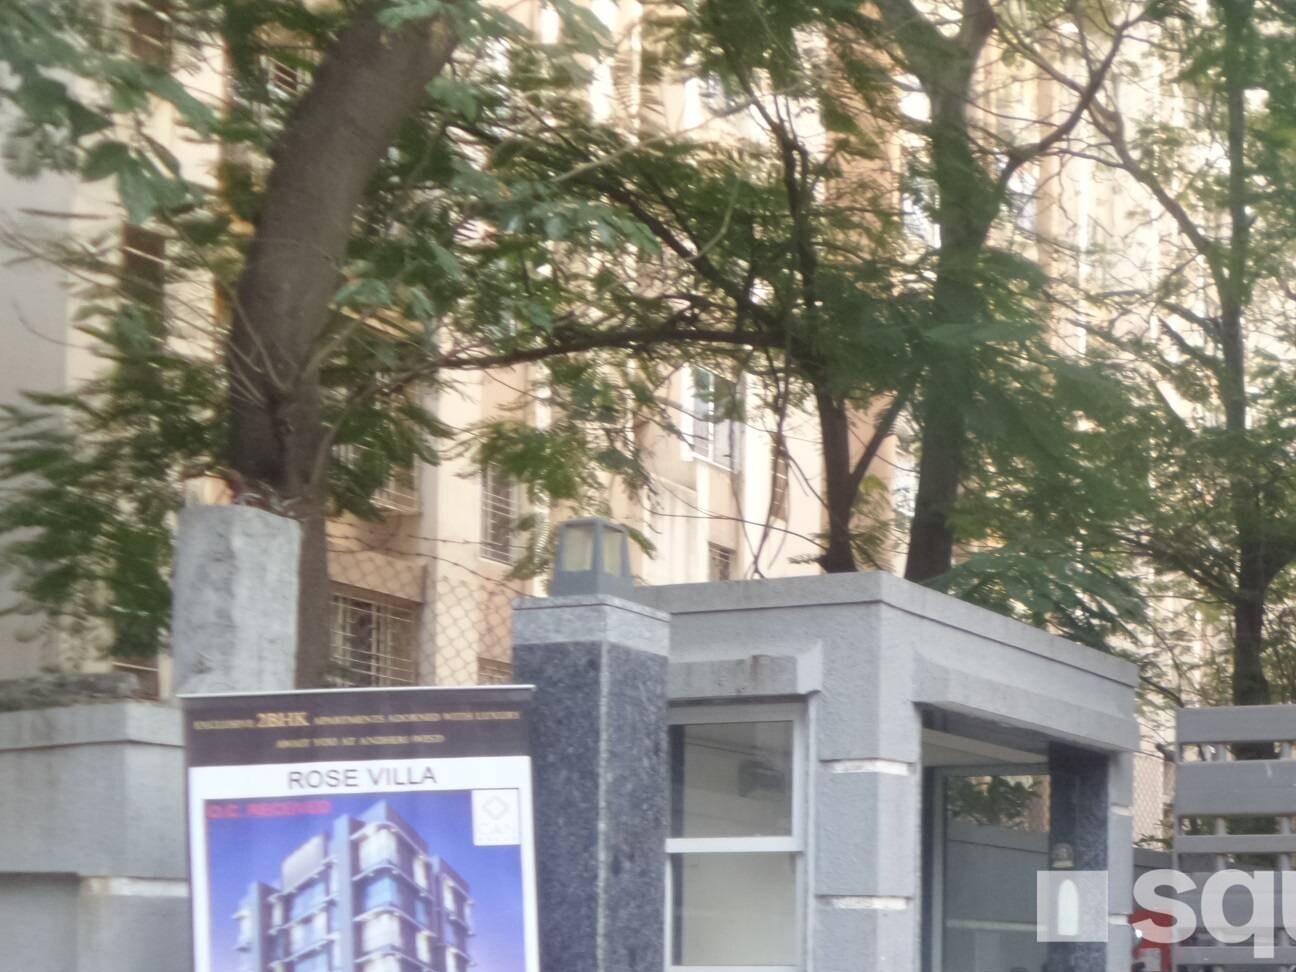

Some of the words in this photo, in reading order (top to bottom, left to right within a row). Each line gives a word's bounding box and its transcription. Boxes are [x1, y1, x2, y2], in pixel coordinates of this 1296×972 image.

[256, 711, 310, 728] 2BHK
[288, 768, 360, 791] ROSE
[366, 765, 438, 787] VILLA
